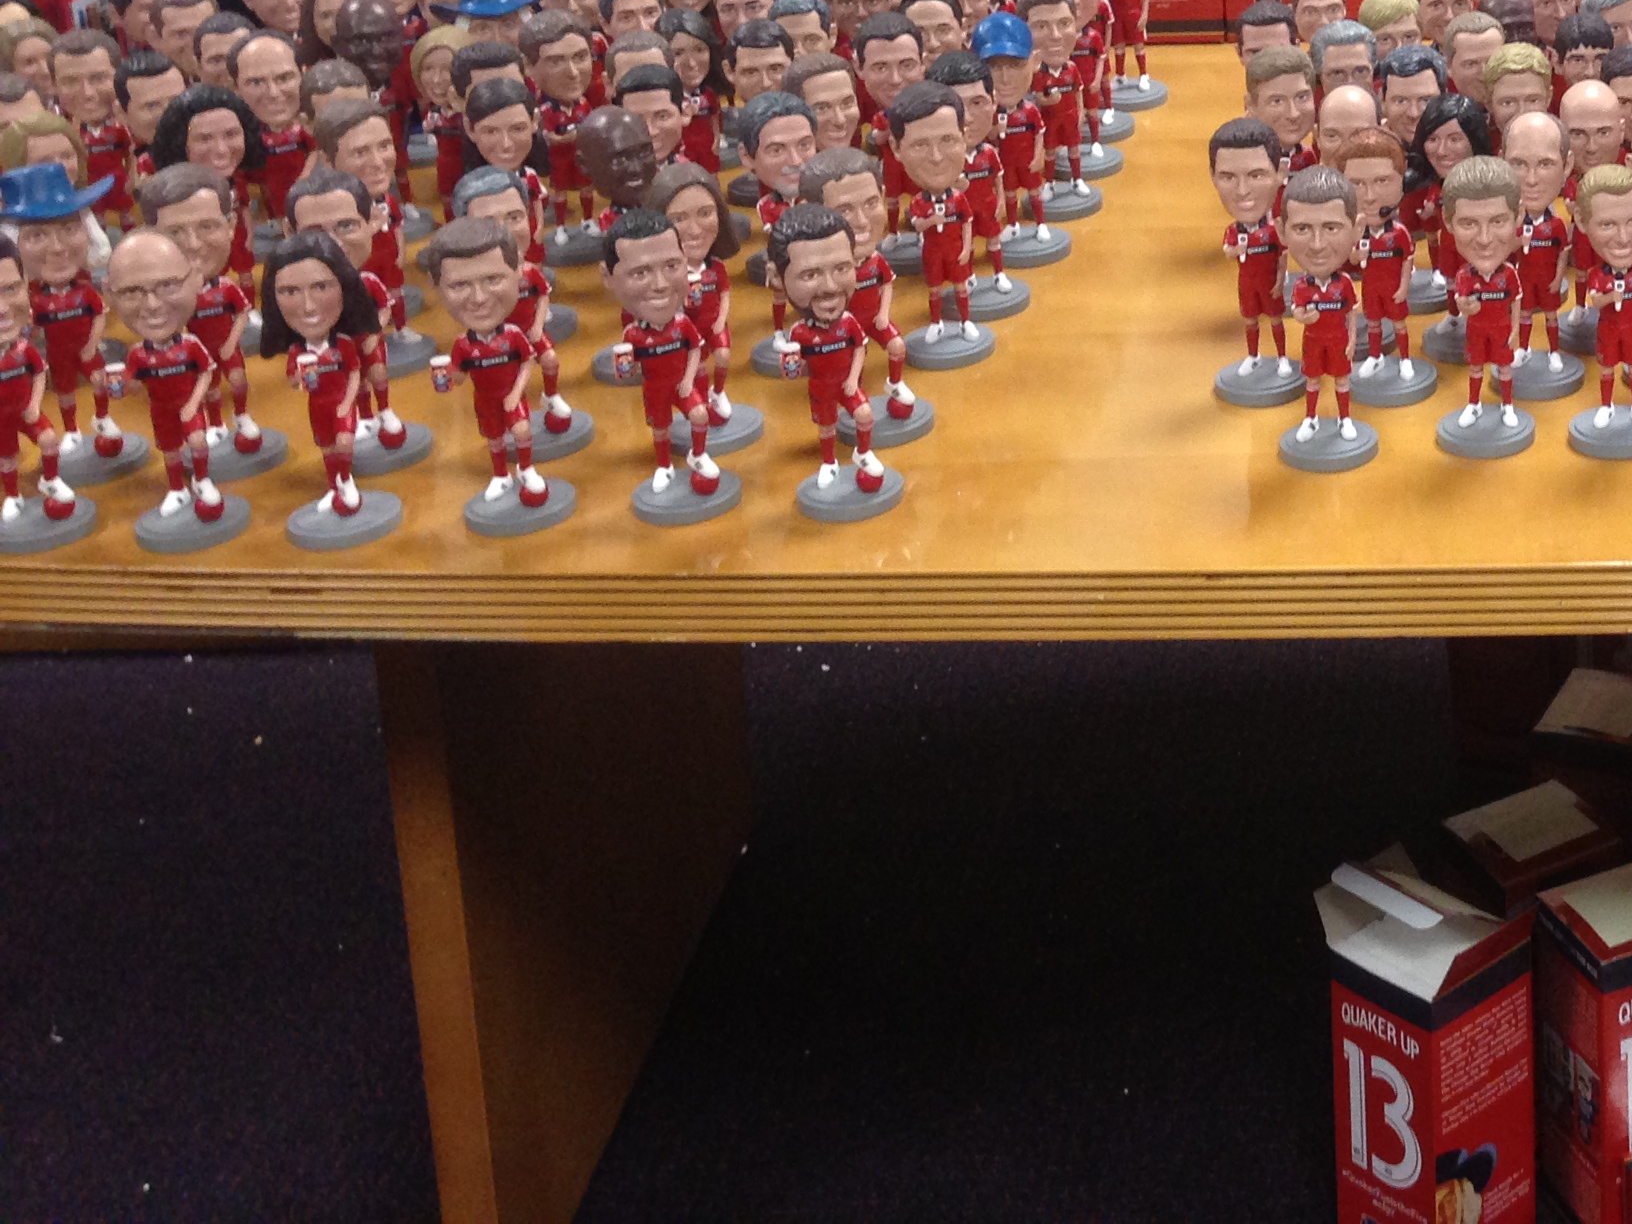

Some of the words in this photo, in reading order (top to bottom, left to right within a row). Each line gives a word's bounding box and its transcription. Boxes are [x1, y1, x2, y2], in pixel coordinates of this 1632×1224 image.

[1341, 1002, 1397, 1046] QUAKER
[1400, 1030, 1420, 1060] UP
[1343, 1037, 1422, 1190] 13
